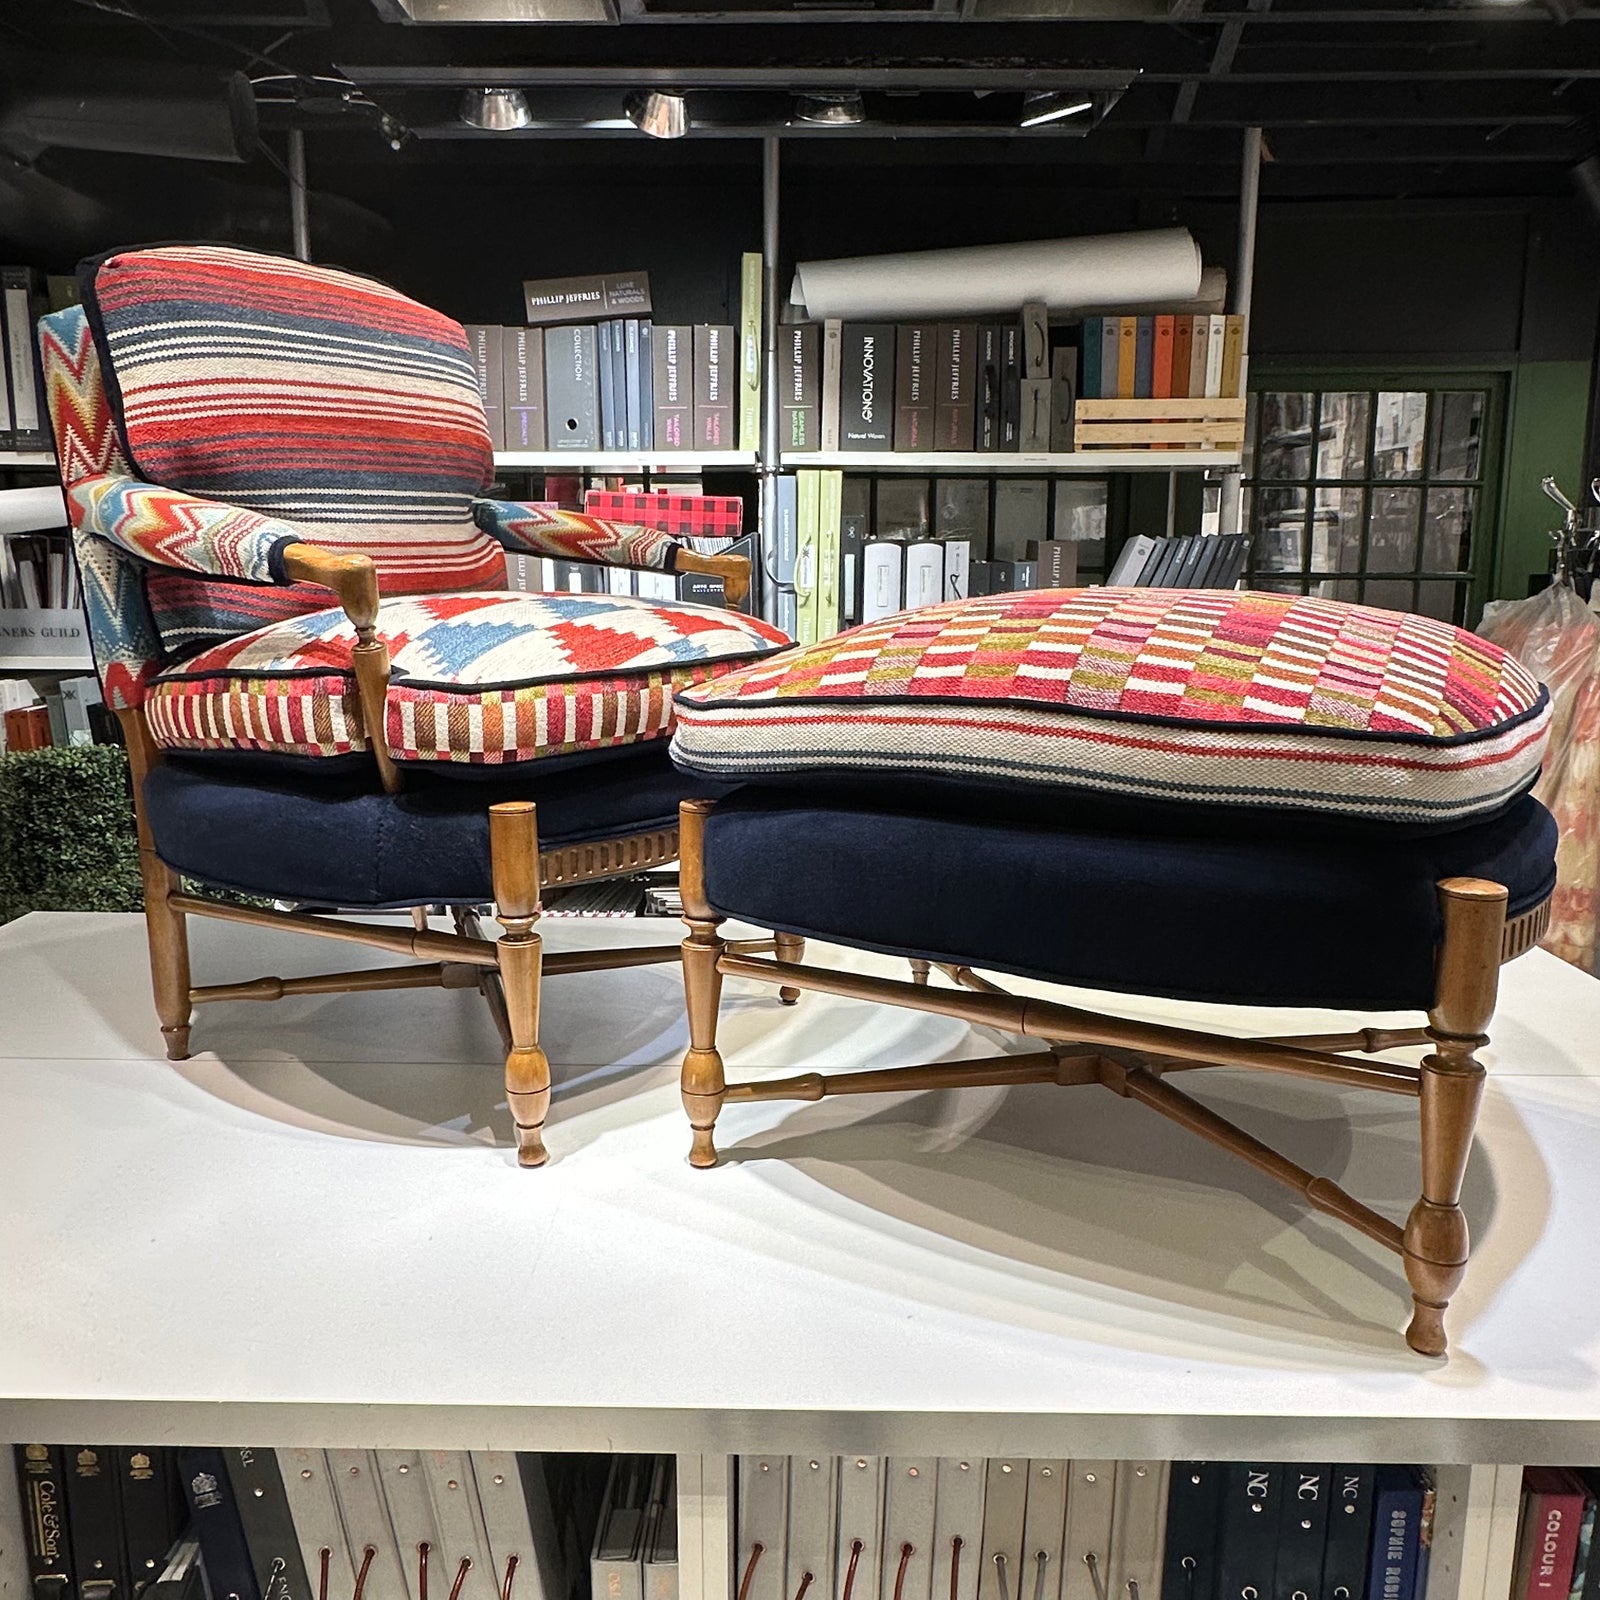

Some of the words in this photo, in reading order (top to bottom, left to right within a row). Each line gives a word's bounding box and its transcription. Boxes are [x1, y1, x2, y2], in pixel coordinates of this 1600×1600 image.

[531, 294, 564, 306] PHILLIP
[566, 291, 601, 305] JEFFRIES
[609, 288, 645, 298] NATURALS
[618, 296, 645, 305] WOODS
[478, 330, 486, 363] PHILLIP
[517, 331, 526, 365] PHILLIP
[573, 328, 583, 381] COLLECTION
[667, 329, 676, 364] PHILLIP
[709, 329, 719, 364] PHILLIP
[793, 330, 802, 364] PHILLIP
[912, 330, 921, 363] PHILLIP
[952, 329, 961, 363] PHILLIP
[518, 366, 527, 402] JEFFRIES
[667, 365, 677, 402] JEFFRIES
[708, 365, 718, 401] JEFFRIES
[793, 365, 803, 402] JEFFRIES
[862, 336, 874, 423] INNOVATIONS
[911, 365, 921, 401] JEFFRIES
[951, 364, 960, 400] JEFFRIES
[1052, 546, 1061, 578] PHILLIP
[0, 627, 35, 638] NERS
[41, 627, 80, 638] GUILD
[1246, 1470, 1270, 1498] NC
[1297, 1474, 1320, 1501] NC
[1342, 1476, 1360, 1499] NC
[39, 1480, 53, 1512] Cole
[46, 1528, 60, 1558] Son
[1387, 1510, 1407, 1560] SOPHIE
[1539, 1509, 1562, 1576] COLOUR
[1383, 1566, 1402, 1600] ROBI
